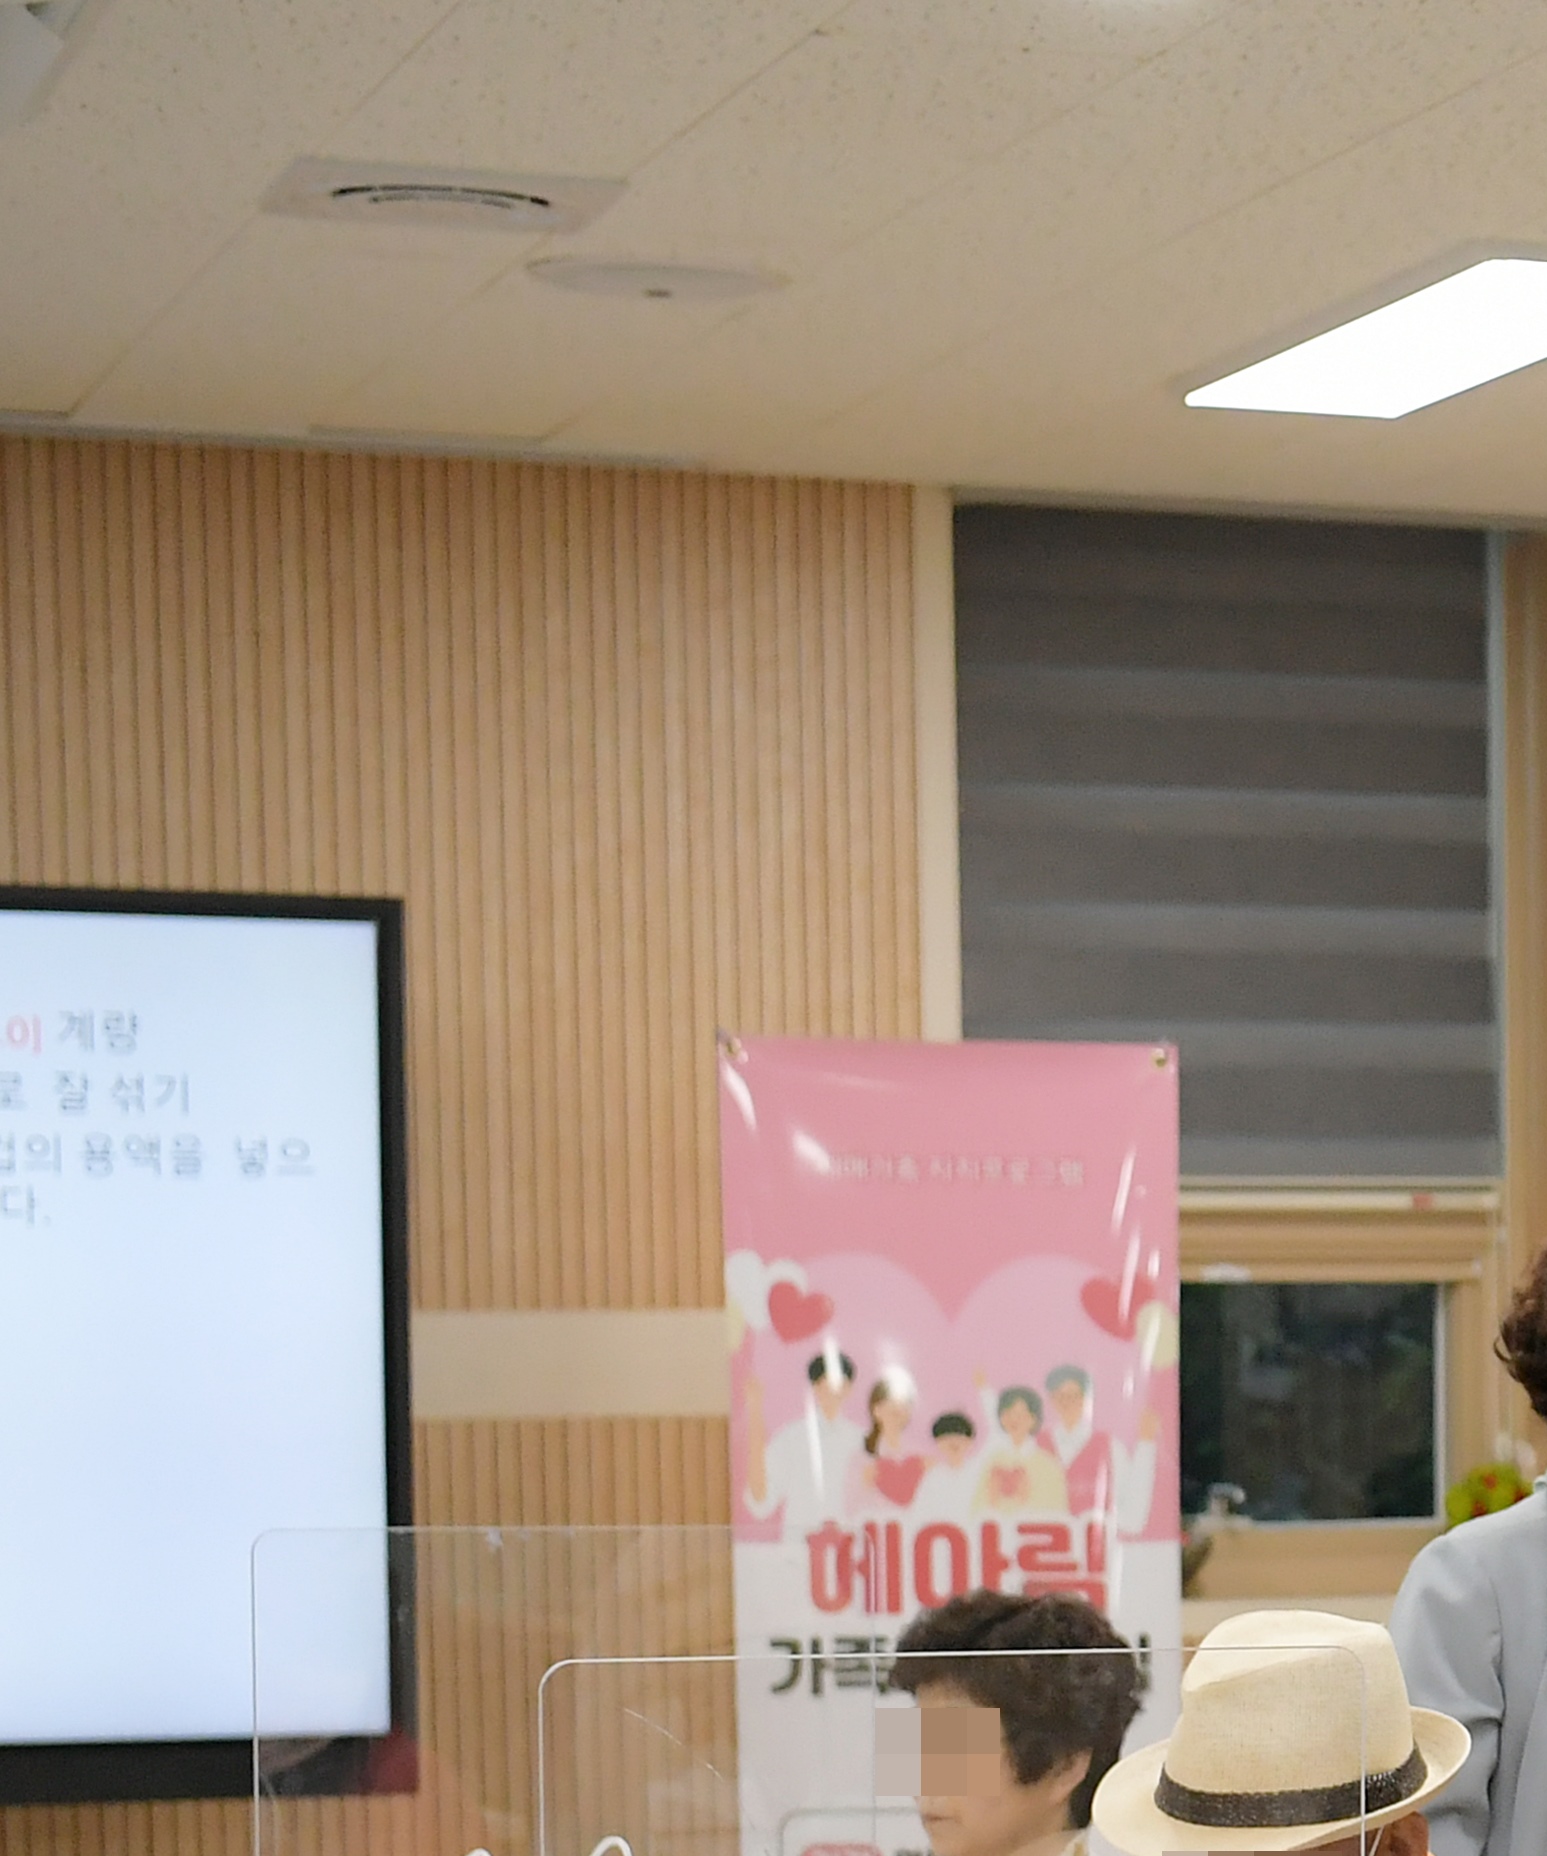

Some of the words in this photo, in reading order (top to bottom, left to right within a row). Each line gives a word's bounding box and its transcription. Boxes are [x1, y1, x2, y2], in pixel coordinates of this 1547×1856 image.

[58, 1008, 139, 1055] 계량
[55, 1069, 90, 1116] 잘
[110, 1070, 190, 1114] 섞기
[83, 1131, 203, 1178] 용액을
[235, 1135, 317, 1177] 넣으
[806, 1519, 1108, 1614] 헤아림
